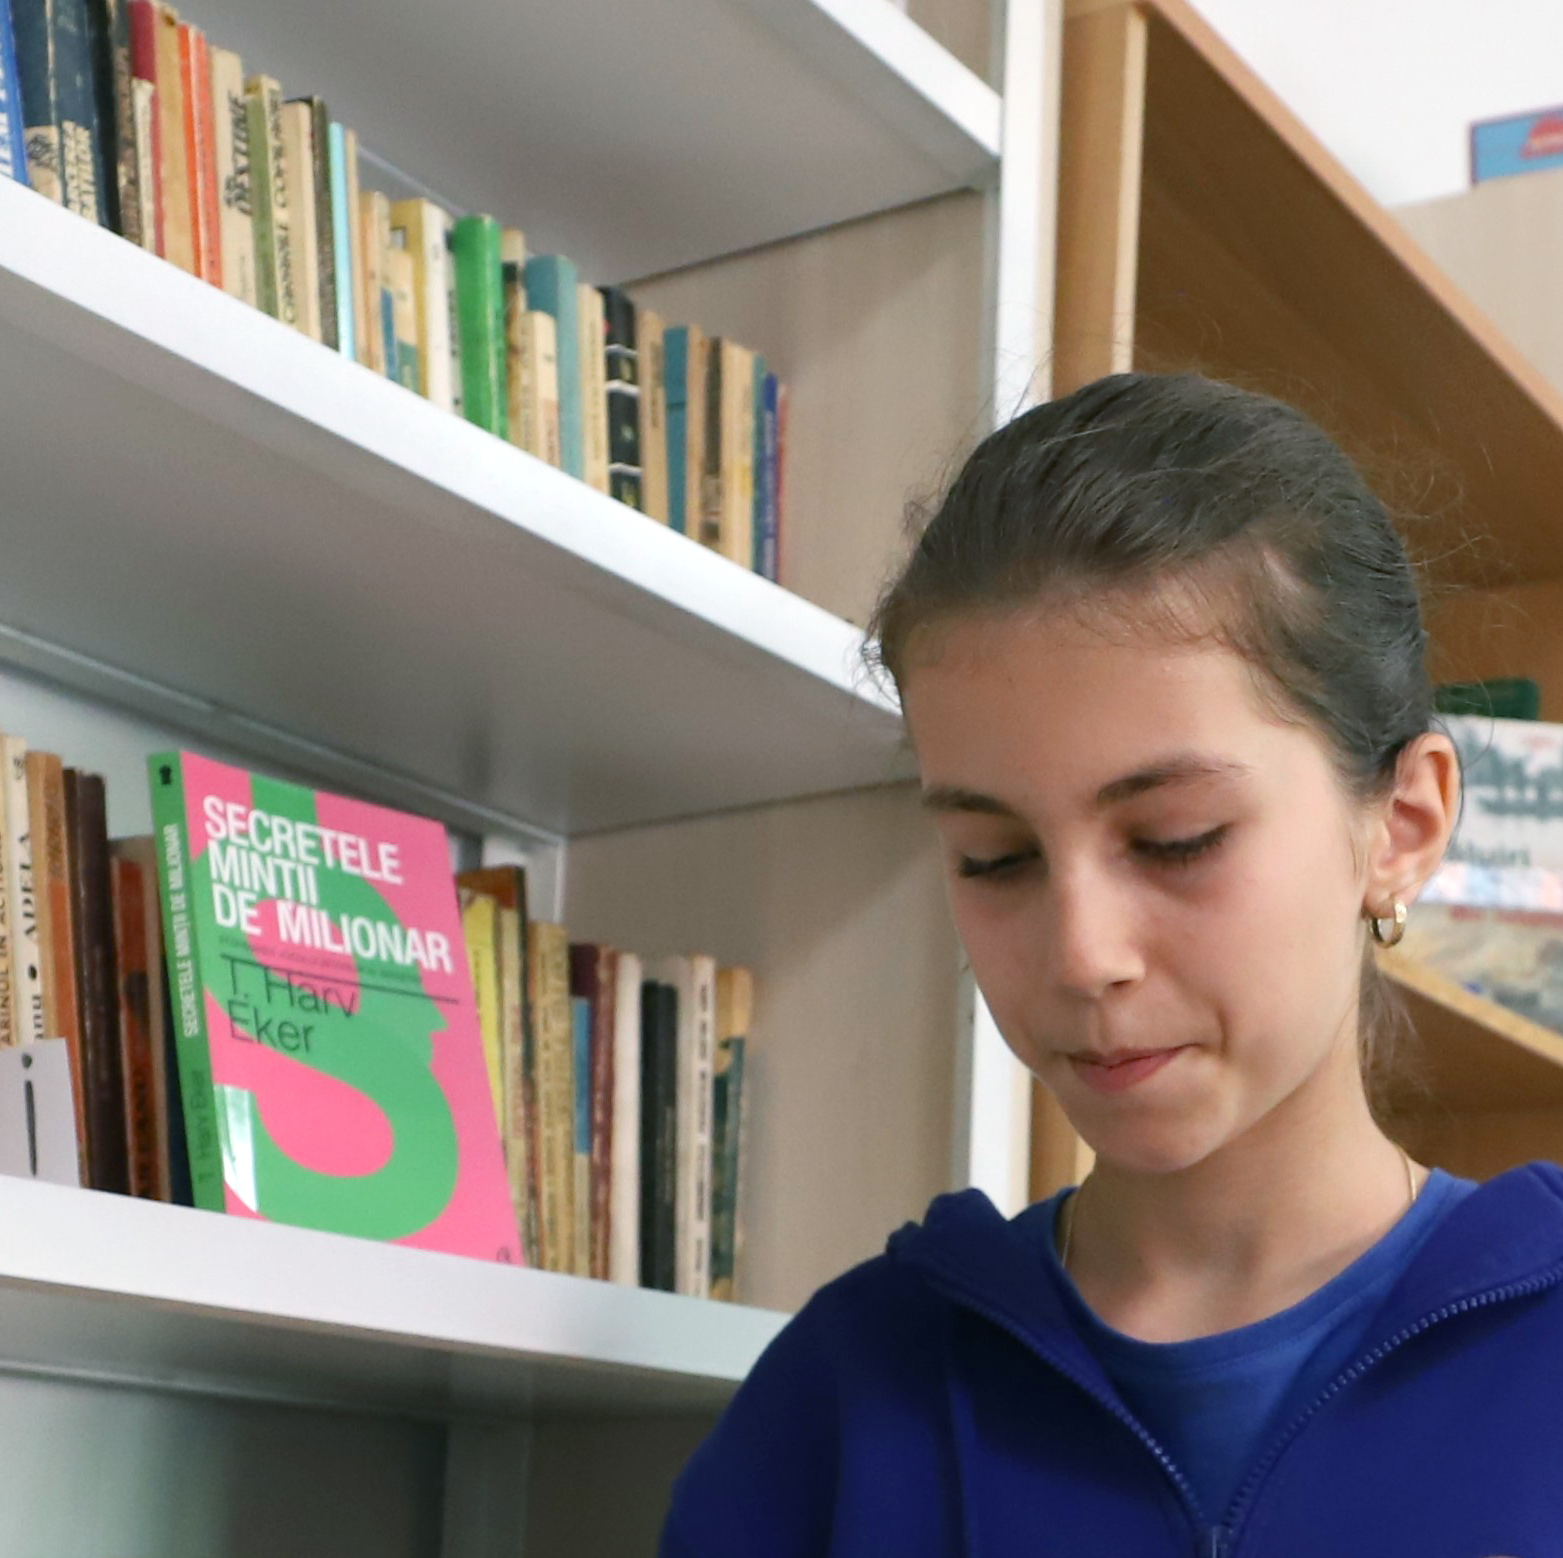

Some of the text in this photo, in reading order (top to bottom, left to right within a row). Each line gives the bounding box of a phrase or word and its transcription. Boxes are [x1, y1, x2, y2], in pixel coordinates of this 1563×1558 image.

[202, 795, 404, 885] SECRETELE
[213, 883, 262, 937] DE
[276, 901, 455, 974] MILIONAR
[227, 999, 315, 1054] Eker
[263, 967, 357, 1018] Harv
